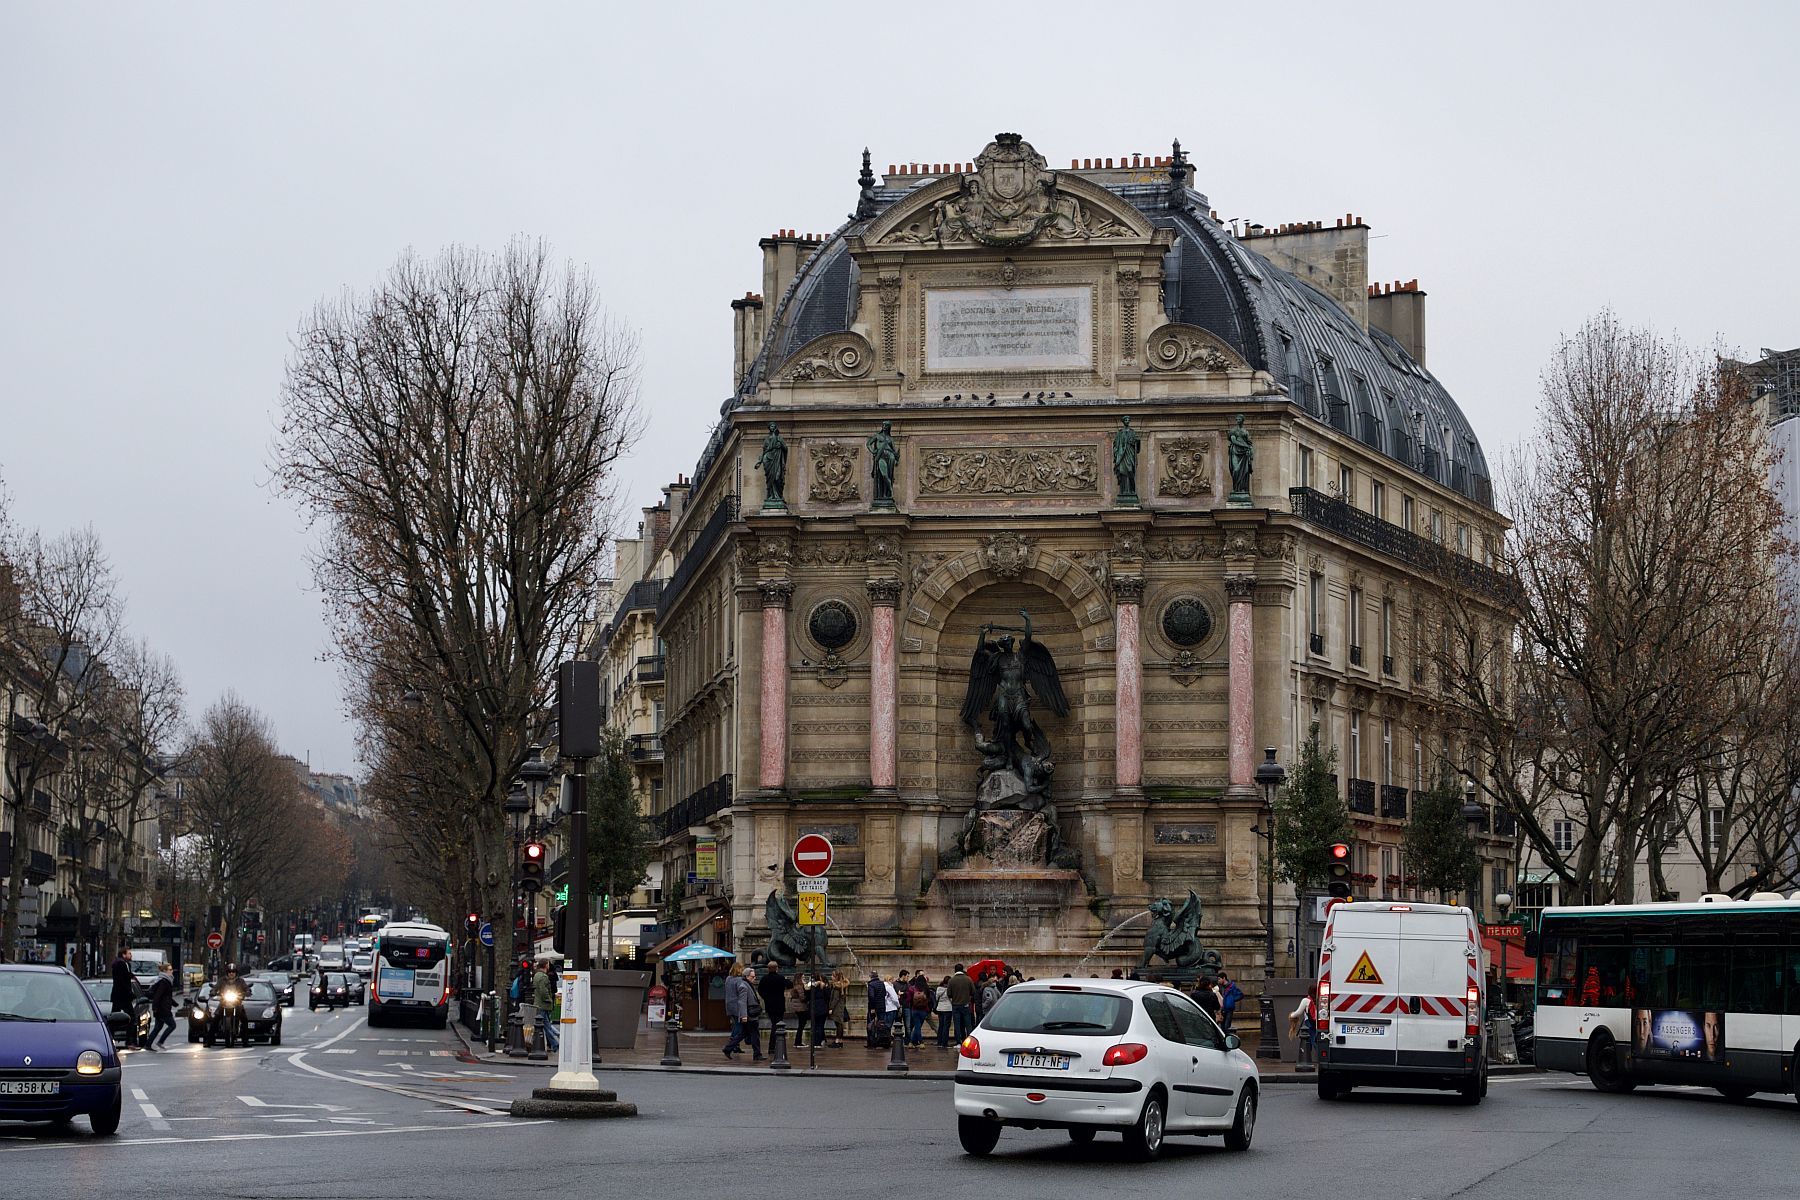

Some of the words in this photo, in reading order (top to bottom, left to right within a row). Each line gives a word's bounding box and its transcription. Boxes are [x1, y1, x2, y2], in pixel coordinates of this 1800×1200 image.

[1001, 305, 1021, 314] SAINT
[1657, 1025, 1696, 1035] PASSENGERS
[1014, 1055, 1063, 1069] DY-767-NF
[0, 1082, 54, 1094] CL-358-KJ
